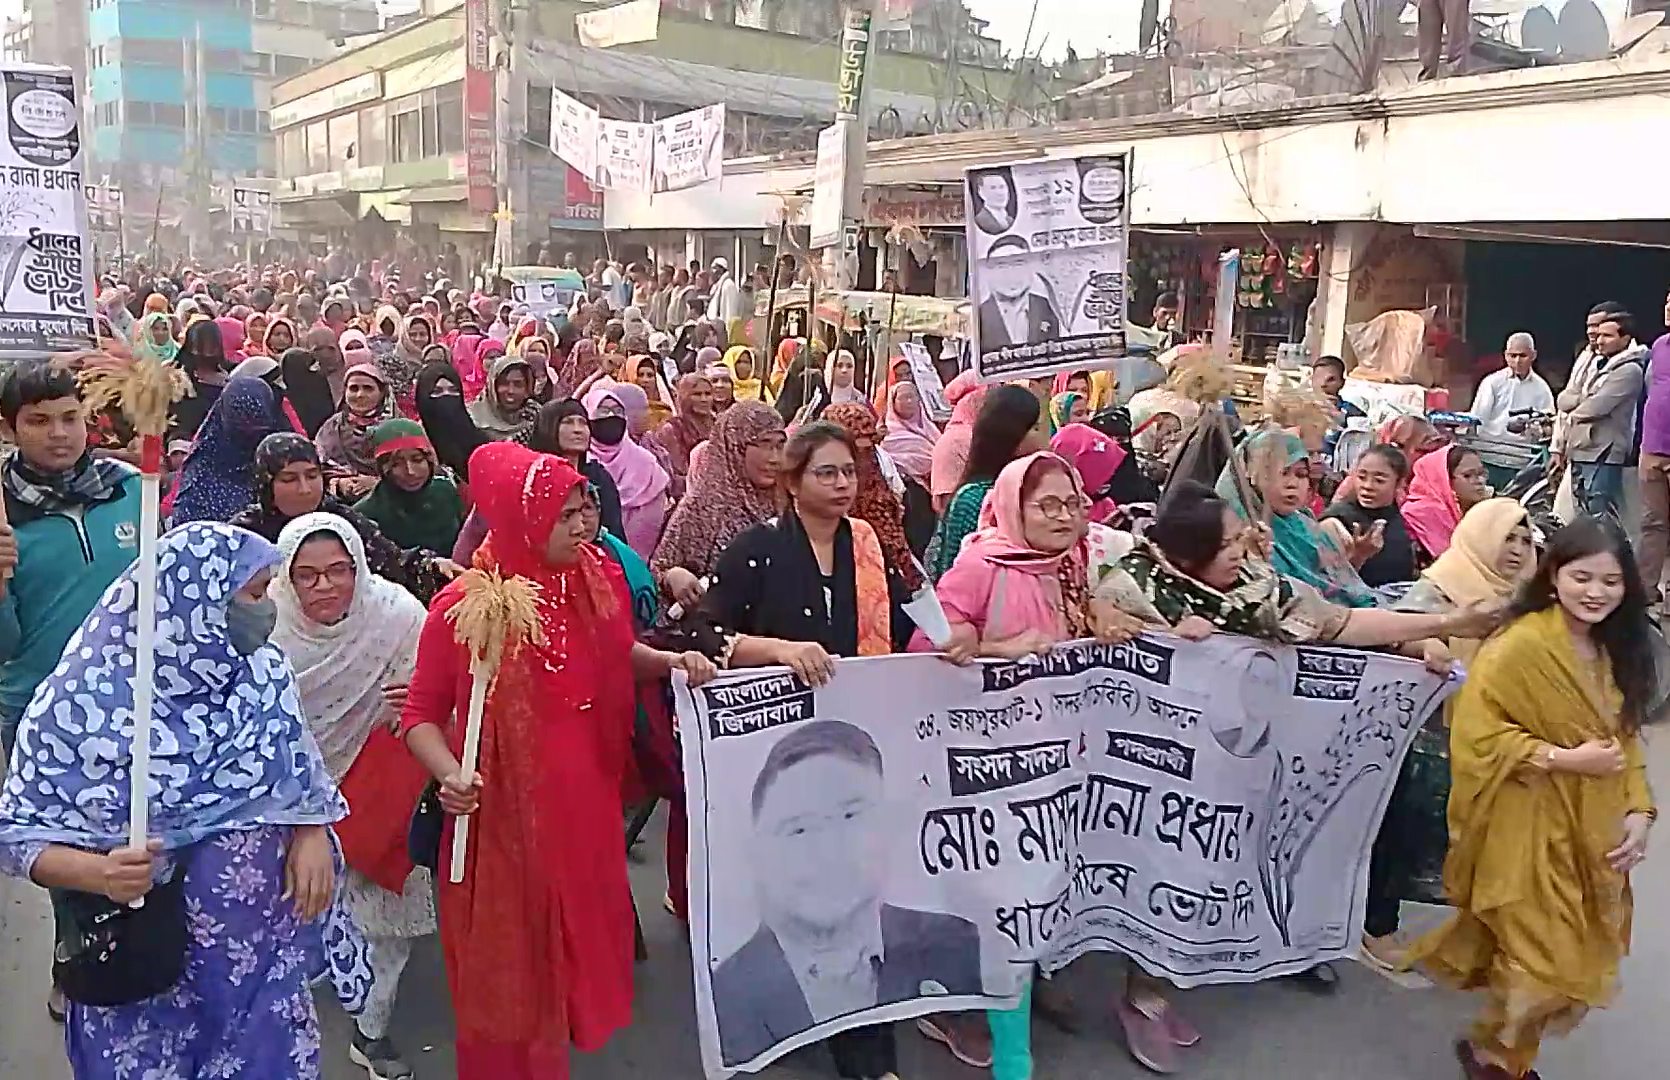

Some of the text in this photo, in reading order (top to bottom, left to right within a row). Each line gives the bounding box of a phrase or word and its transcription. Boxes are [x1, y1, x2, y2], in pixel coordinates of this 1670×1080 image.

[9, 165, 40, 188] রানা
[43, 168, 81, 191] প্রধান
[26, 227, 82, 256] ধানের
[710, 672, 798, 706] বাংলাদেশ
[714, 699, 805, 734] জিন্দাবাদ
[953, 752, 1014, 784] সংসদ
[918, 806, 999, 876] মোঃ
[1147, 881, 1229, 930] ভোট
